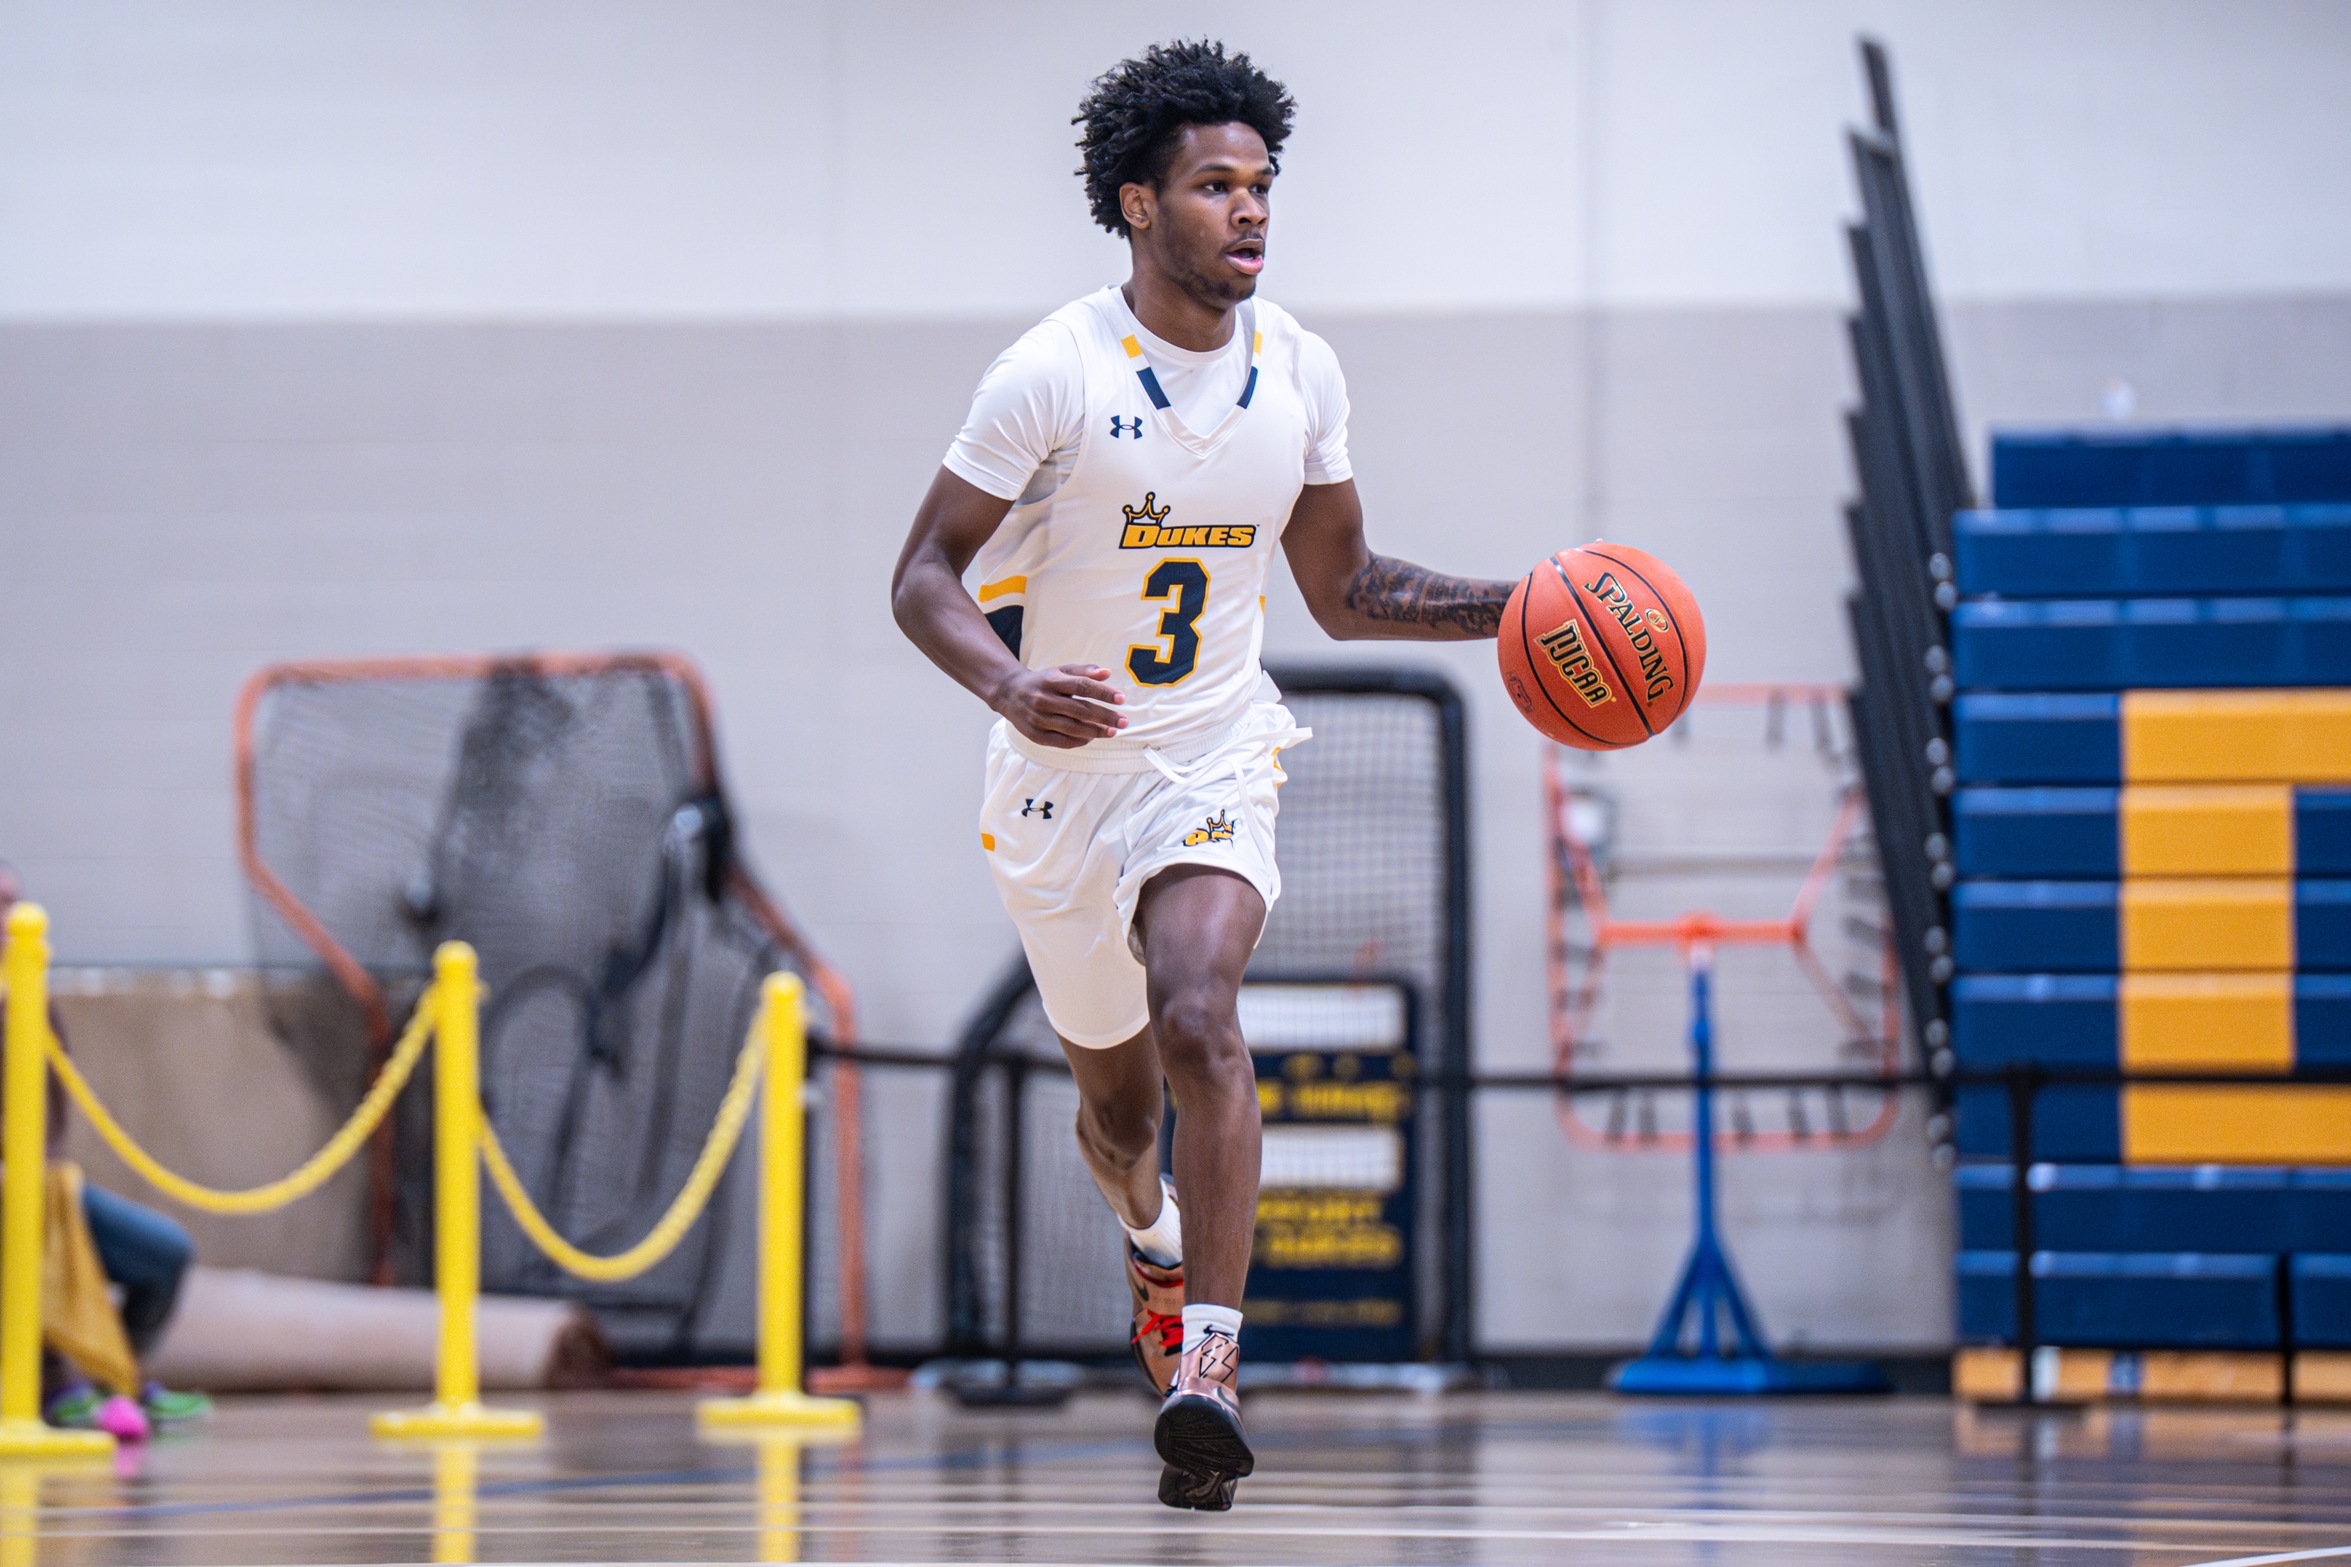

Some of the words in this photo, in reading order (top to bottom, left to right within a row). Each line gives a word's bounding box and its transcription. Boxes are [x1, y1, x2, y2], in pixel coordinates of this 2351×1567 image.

[1119, 524, 1256, 549] DUKES
[1125, 558, 1211, 688] 3
[1534, 619, 1611, 708] NJCAA
[1583, 572, 1675, 702] SPALDING
